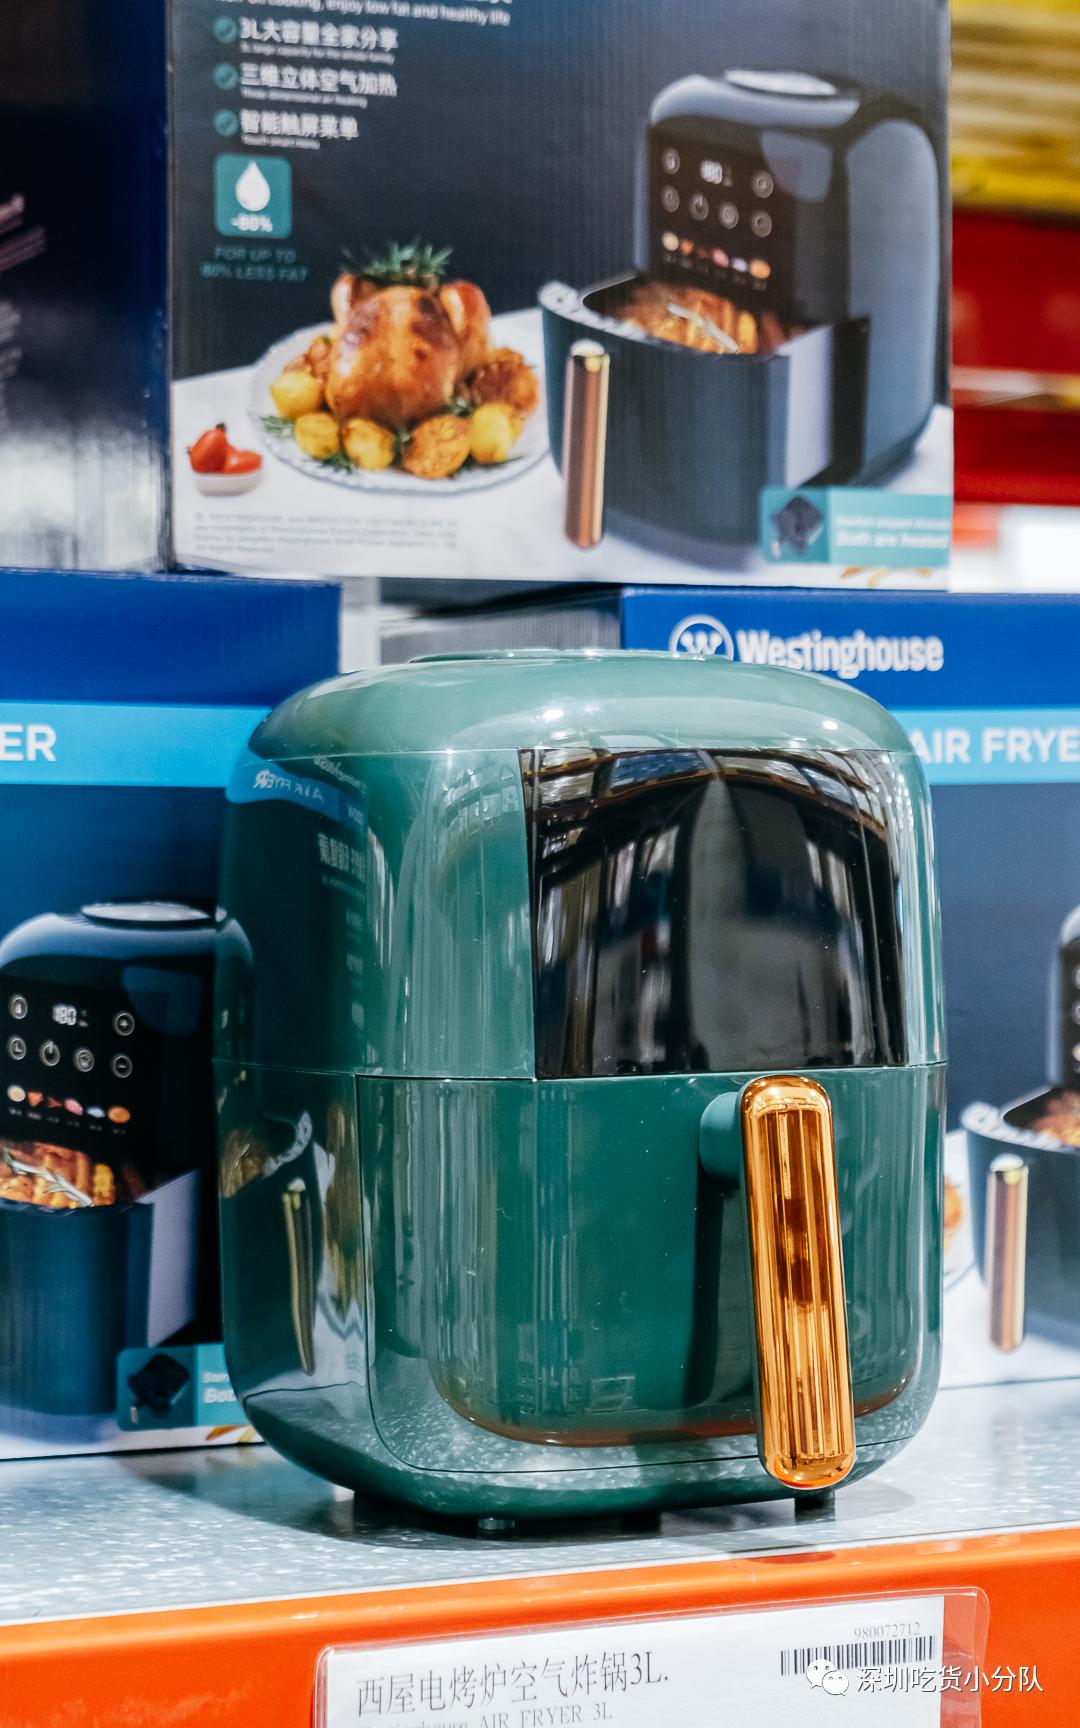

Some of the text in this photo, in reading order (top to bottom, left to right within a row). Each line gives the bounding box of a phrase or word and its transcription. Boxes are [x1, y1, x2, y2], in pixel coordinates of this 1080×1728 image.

[735, 628, 944, 679] Westinghouse
[0, 724, 57, 762] ER
[909, 727, 971, 764] AIR
[854, 1621, 921, 1640] 980072712
[355, 1651, 669, 1718] 西屋电烤炉空气炸锅3L.
[521, 1703, 582, 1728] FRYER
[593, 1701, 613, 1721] 3L
